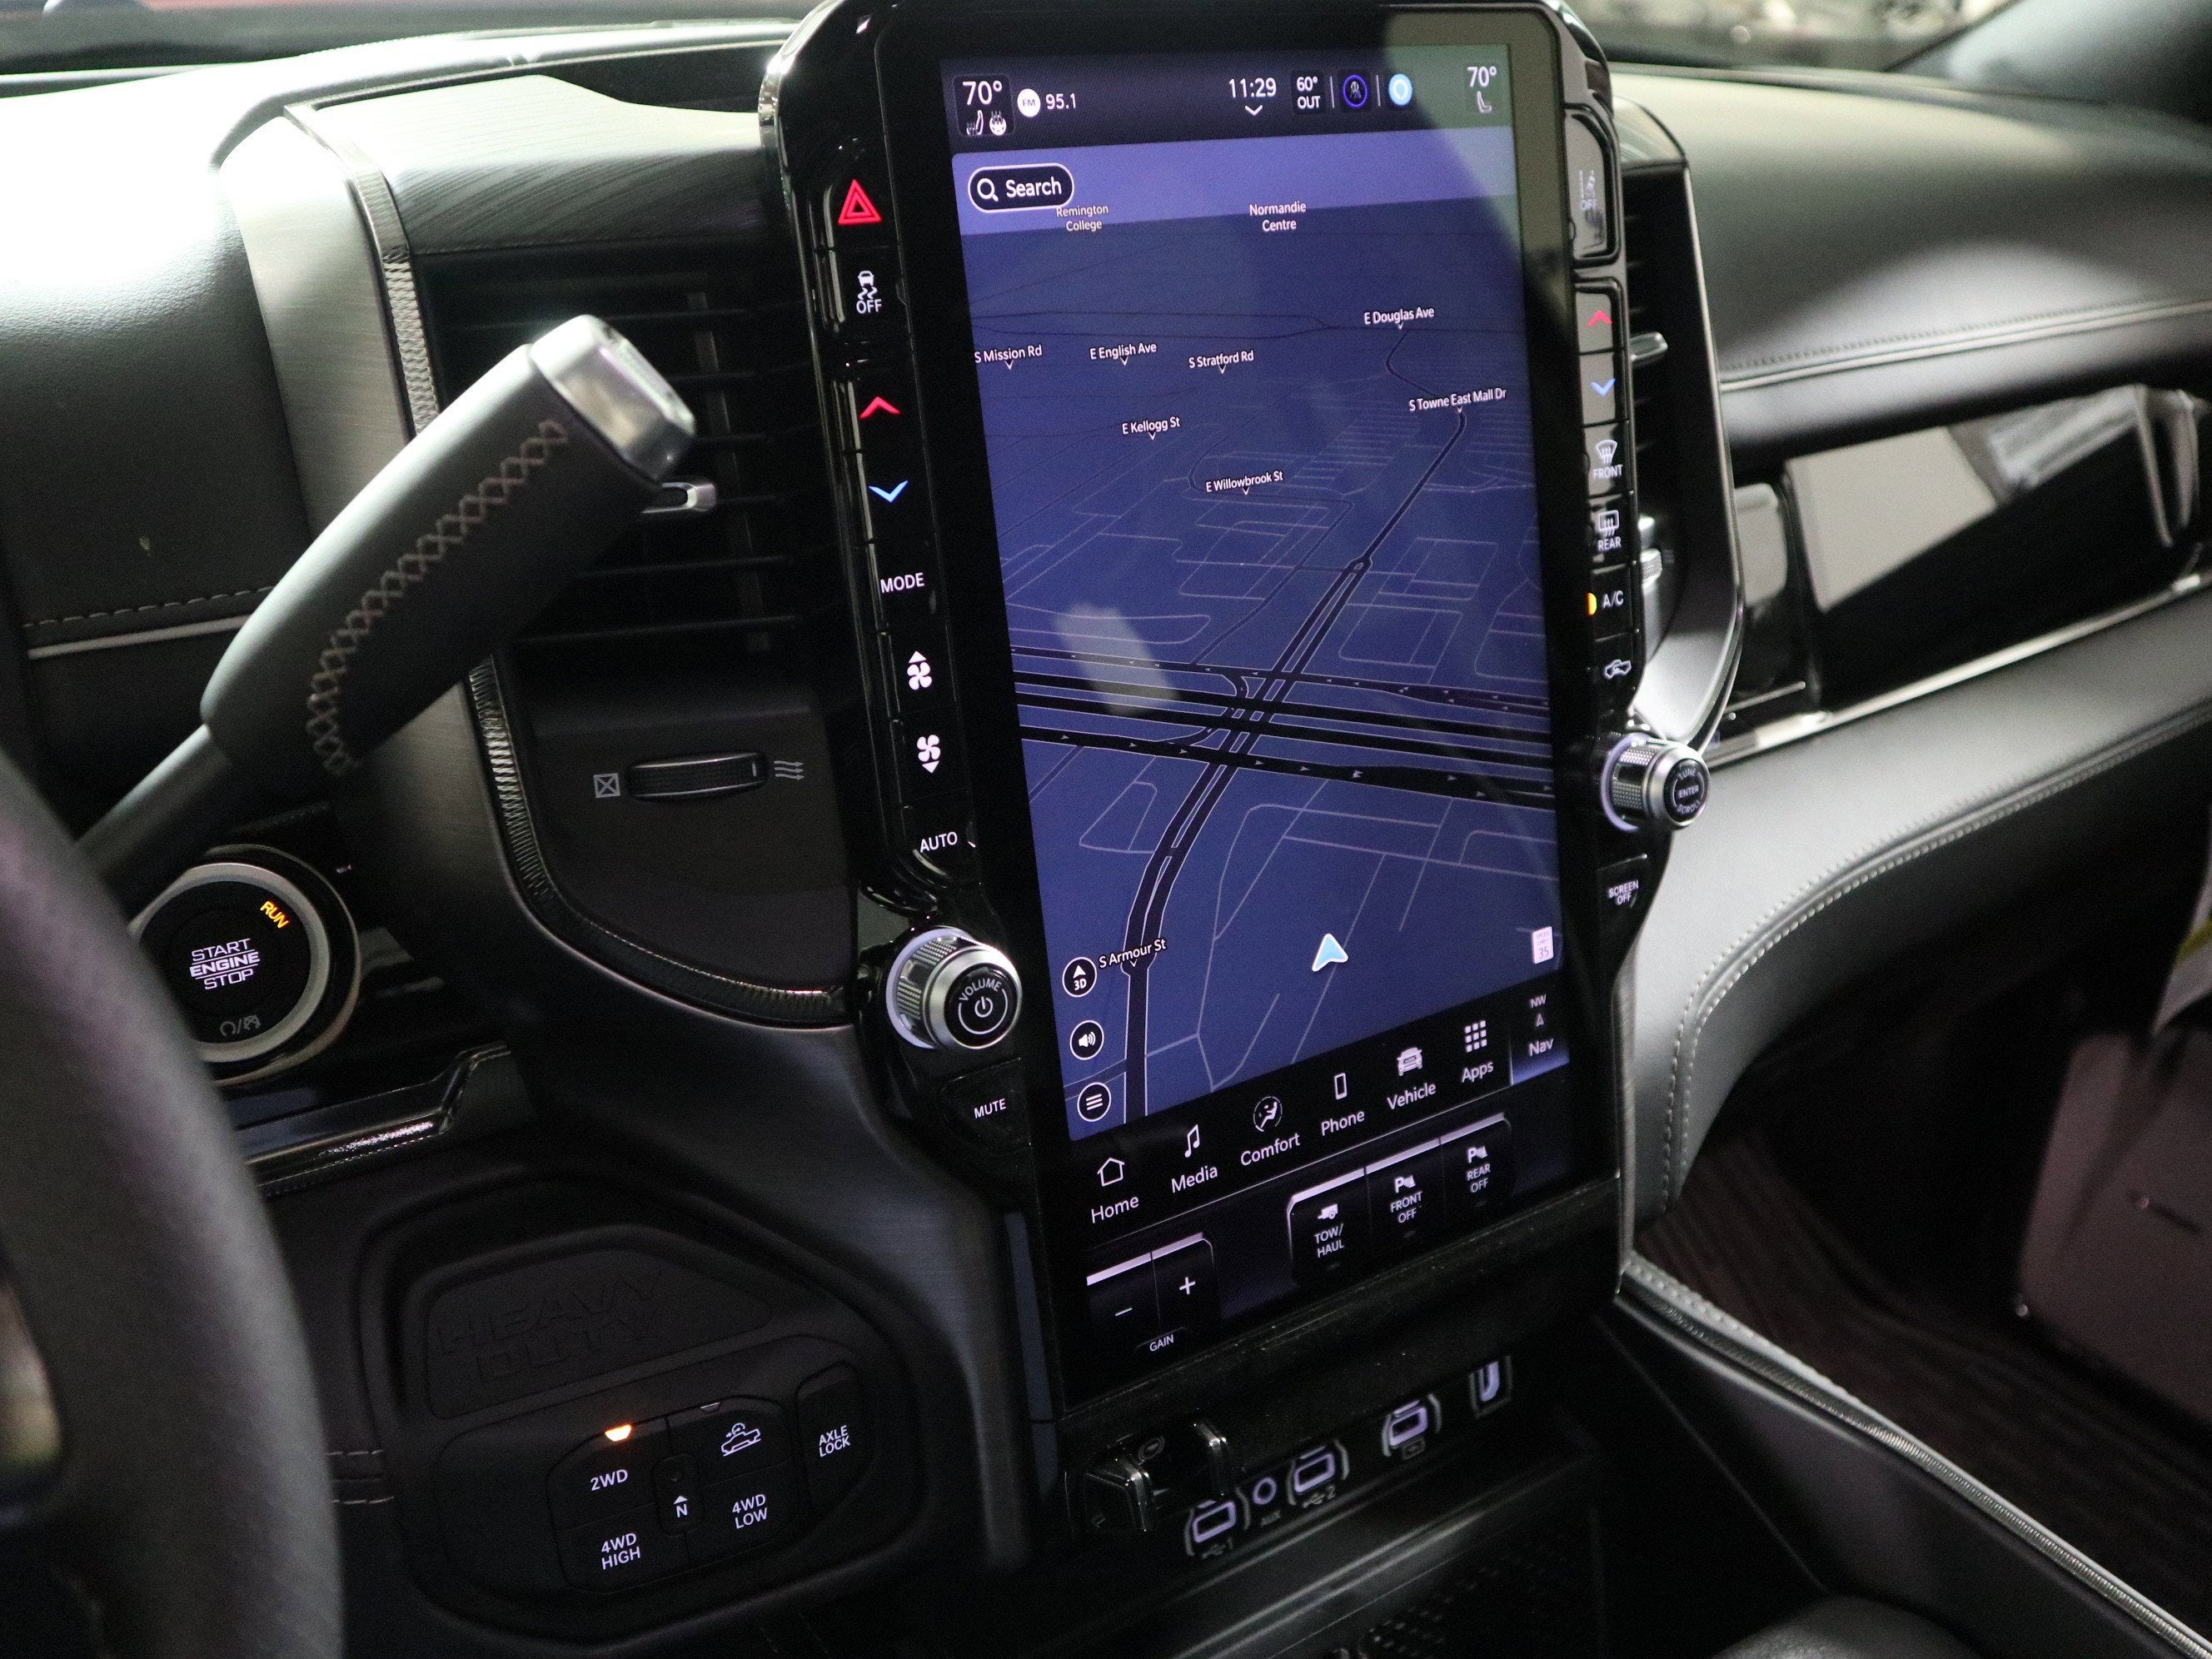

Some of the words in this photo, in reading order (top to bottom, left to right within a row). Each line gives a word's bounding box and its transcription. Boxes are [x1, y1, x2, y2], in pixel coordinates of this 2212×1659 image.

[1296, 76, 1318, 92] 60°
[1467, 66, 1497, 87] 70°
[963, 81, 1002, 106] 70°
[1228, 77, 1278, 98] 11:29
[1045, 92, 1076, 110] 95.1
[1297, 95, 1321, 109] OUT
[1005, 176, 1062, 198] Search
[1056, 203, 1109, 217] Remington
[1249, 200, 1307, 217] Normandie
[1065, 218, 1103, 232] College
[1262, 218, 1297, 232] Centre
[856, 298, 882, 314] OFF
[1364, 312, 1372, 325] E
[1373, 307, 1415, 324] Douglas
[1416, 306, 1435, 320] Ave
[974, 351, 982, 363] S
[984, 346, 1026, 363] Mission
[1028, 344, 1043, 358] Rd
[1089, 348, 1097, 360] E
[1099, 344, 1136, 359] English
[1137, 342, 1158, 356] Ave
[1188, 356, 1195, 369] S
[1197, 353, 1239, 368] Stratford
[1241, 350, 1254, 362] Rd
[1408, 399, 1416, 411] S
[1417, 395, 1449, 411] Towne
[1451, 392, 1472, 406] East
[1472, 389, 1494, 403] Mall
[1495, 387, 1507, 400] Dr
[1122, 423, 1128, 435] E
[1130, 418, 1168, 433] Kellogg
[1170, 416, 1181, 428] St
[1206, 481, 1212, 493] E
[1213, 472, 1272, 492] Willowbrook
[1273, 471, 1283, 482] St
[1593, 464, 1623, 480] FRONT
[1598, 536, 1622, 551] REAR
[880, 572, 925, 594] MODE
[1602, 590, 1624, 609] A/C
[1679, 785, 1700, 799] ENTER
[919, 831, 958, 853] AUTO
[1607, 879, 1639, 899] SCREEN
[1616, 892, 1632, 905] OFF
[260, 900, 290, 929] RUN
[192, 938, 250, 962] START
[1099, 954, 1107, 969] S
[1108, 944, 1152, 966] Armour
[1153, 938, 1167, 952] St
[189, 951, 261, 977] ENGINE
[204, 968, 254, 990] STOP
[959, 978, 1002, 1001] VOLUME
[1073, 978, 1087, 991] 3D
[1530, 994, 1547, 1009] NW
[1528, 1038, 1554, 1057] Nav
[1461, 1060, 1494, 1084] Apps
[1387, 1083, 1437, 1110] Vehicle
[974, 1098, 1007, 1119] MUTE
[1321, 1110, 1365, 1136] Phone
[1240, 1133, 1301, 1166] Comfort
[1171, 1165, 1218, 1193] Media
[1467, 1163, 1491, 1181] REAR
[1470, 1178, 1489, 1193] OFF
[1090, 1196, 1139, 1224] Home
[1390, 1191, 1423, 1213] FRONT
[1397, 1208, 1417, 1223] OFF
[1314, 1223, 1344, 1244] TOW/
[1317, 1240, 1345, 1258] HAUL
[1149, 1334, 1174, 1352] GAIN
[819, 1425, 849, 1447] AXLE
[819, 1435, 851, 1457] LOCK
[590, 1469, 628, 1491] 2WD
[675, 1503, 688, 1517] N
[732, 1493, 766, 1514] 4WD
[735, 1507, 768, 1529] LOW
[601, 1532, 637, 1553] 4WD
[601, 1547, 641, 1570] HIGH
